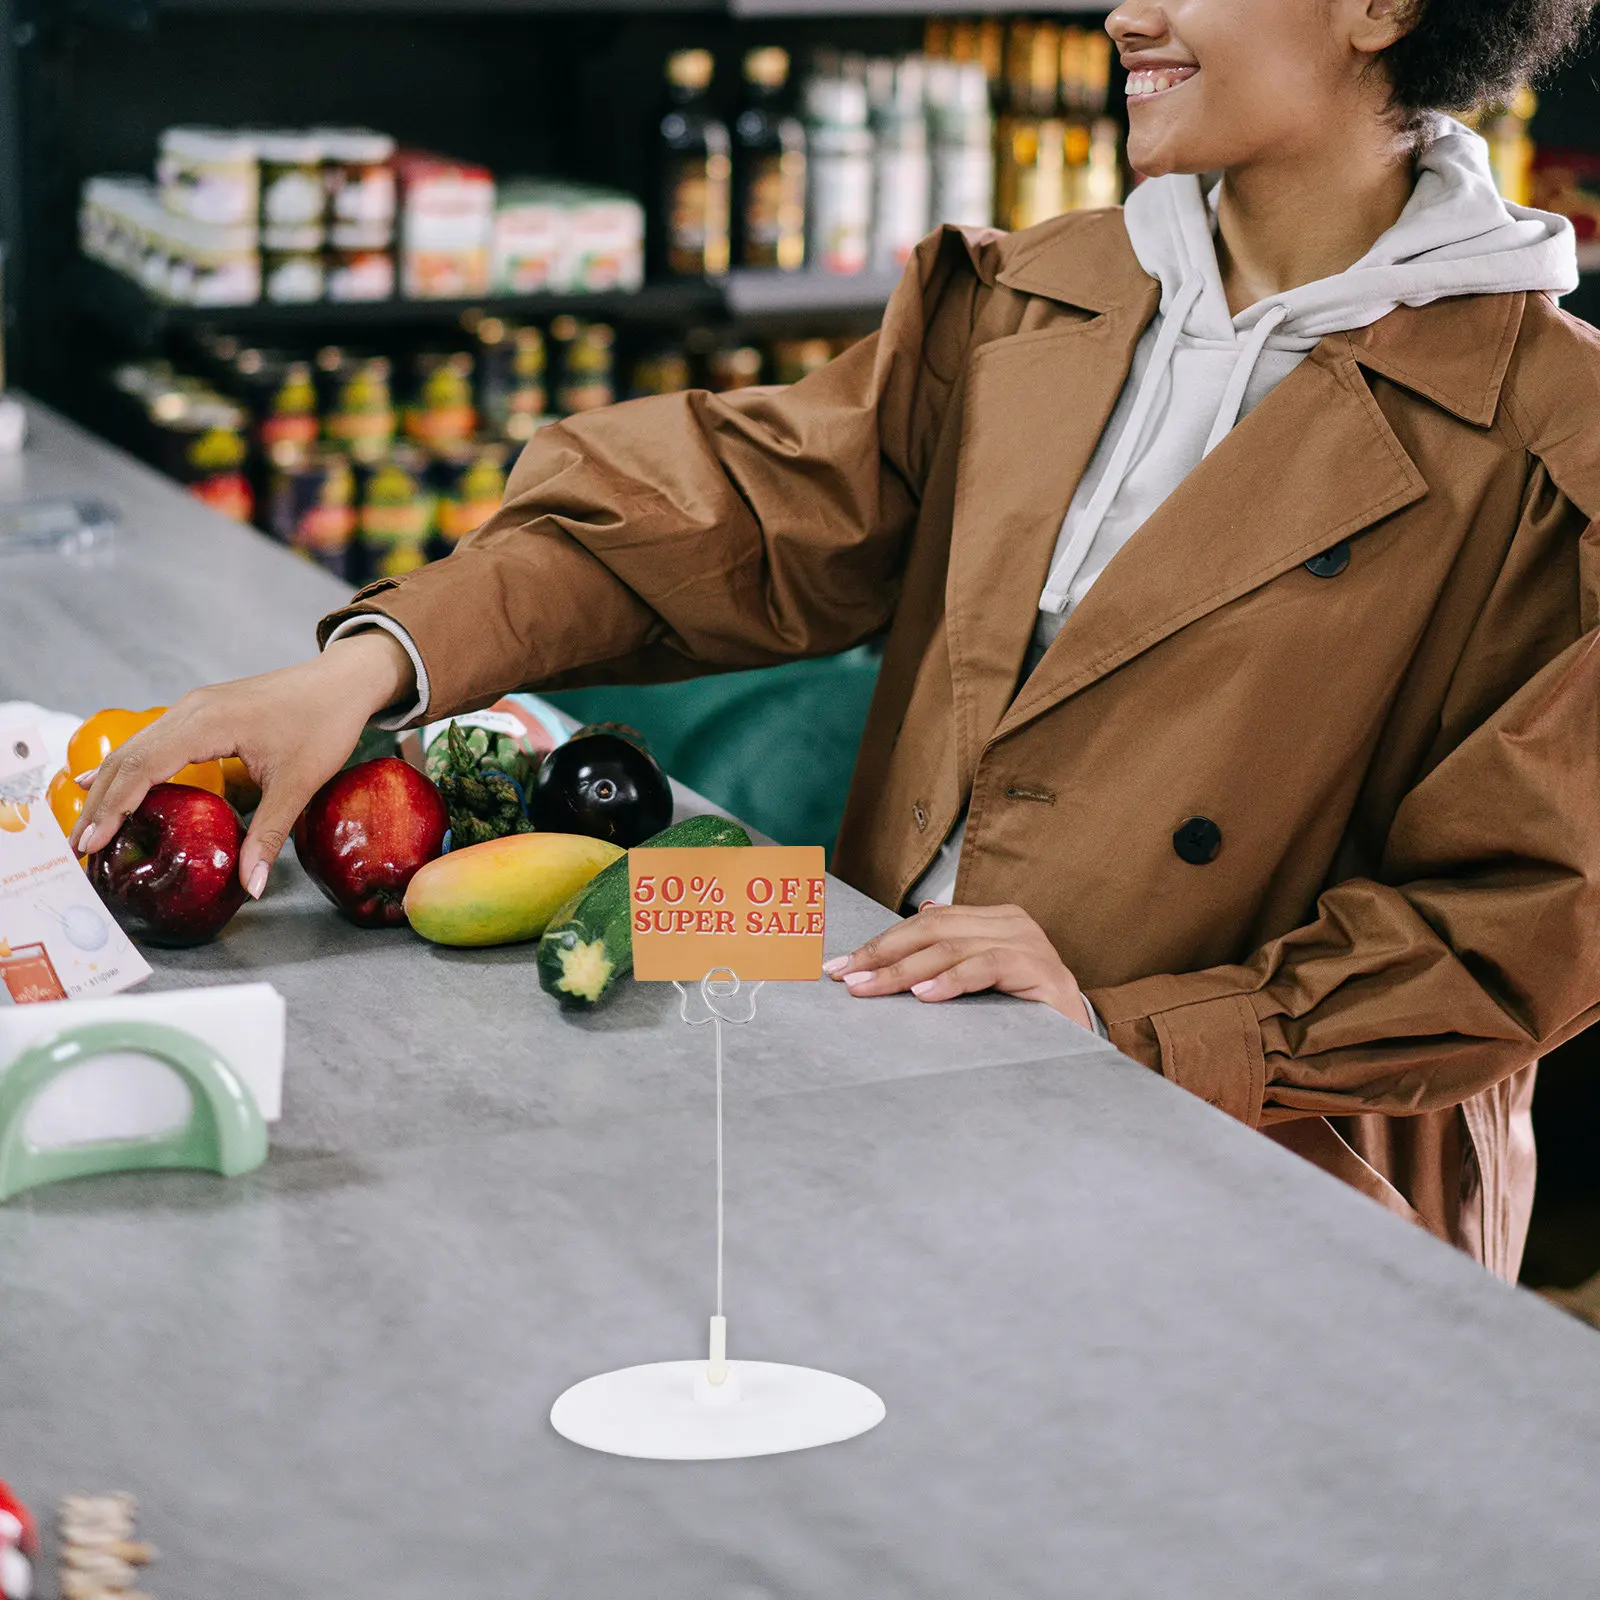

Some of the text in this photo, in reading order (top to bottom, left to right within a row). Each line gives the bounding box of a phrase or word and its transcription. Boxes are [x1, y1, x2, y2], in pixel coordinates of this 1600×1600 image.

[633, 875, 825, 907] 50% OFF
[633, 909, 825, 936] SUPER SALE
